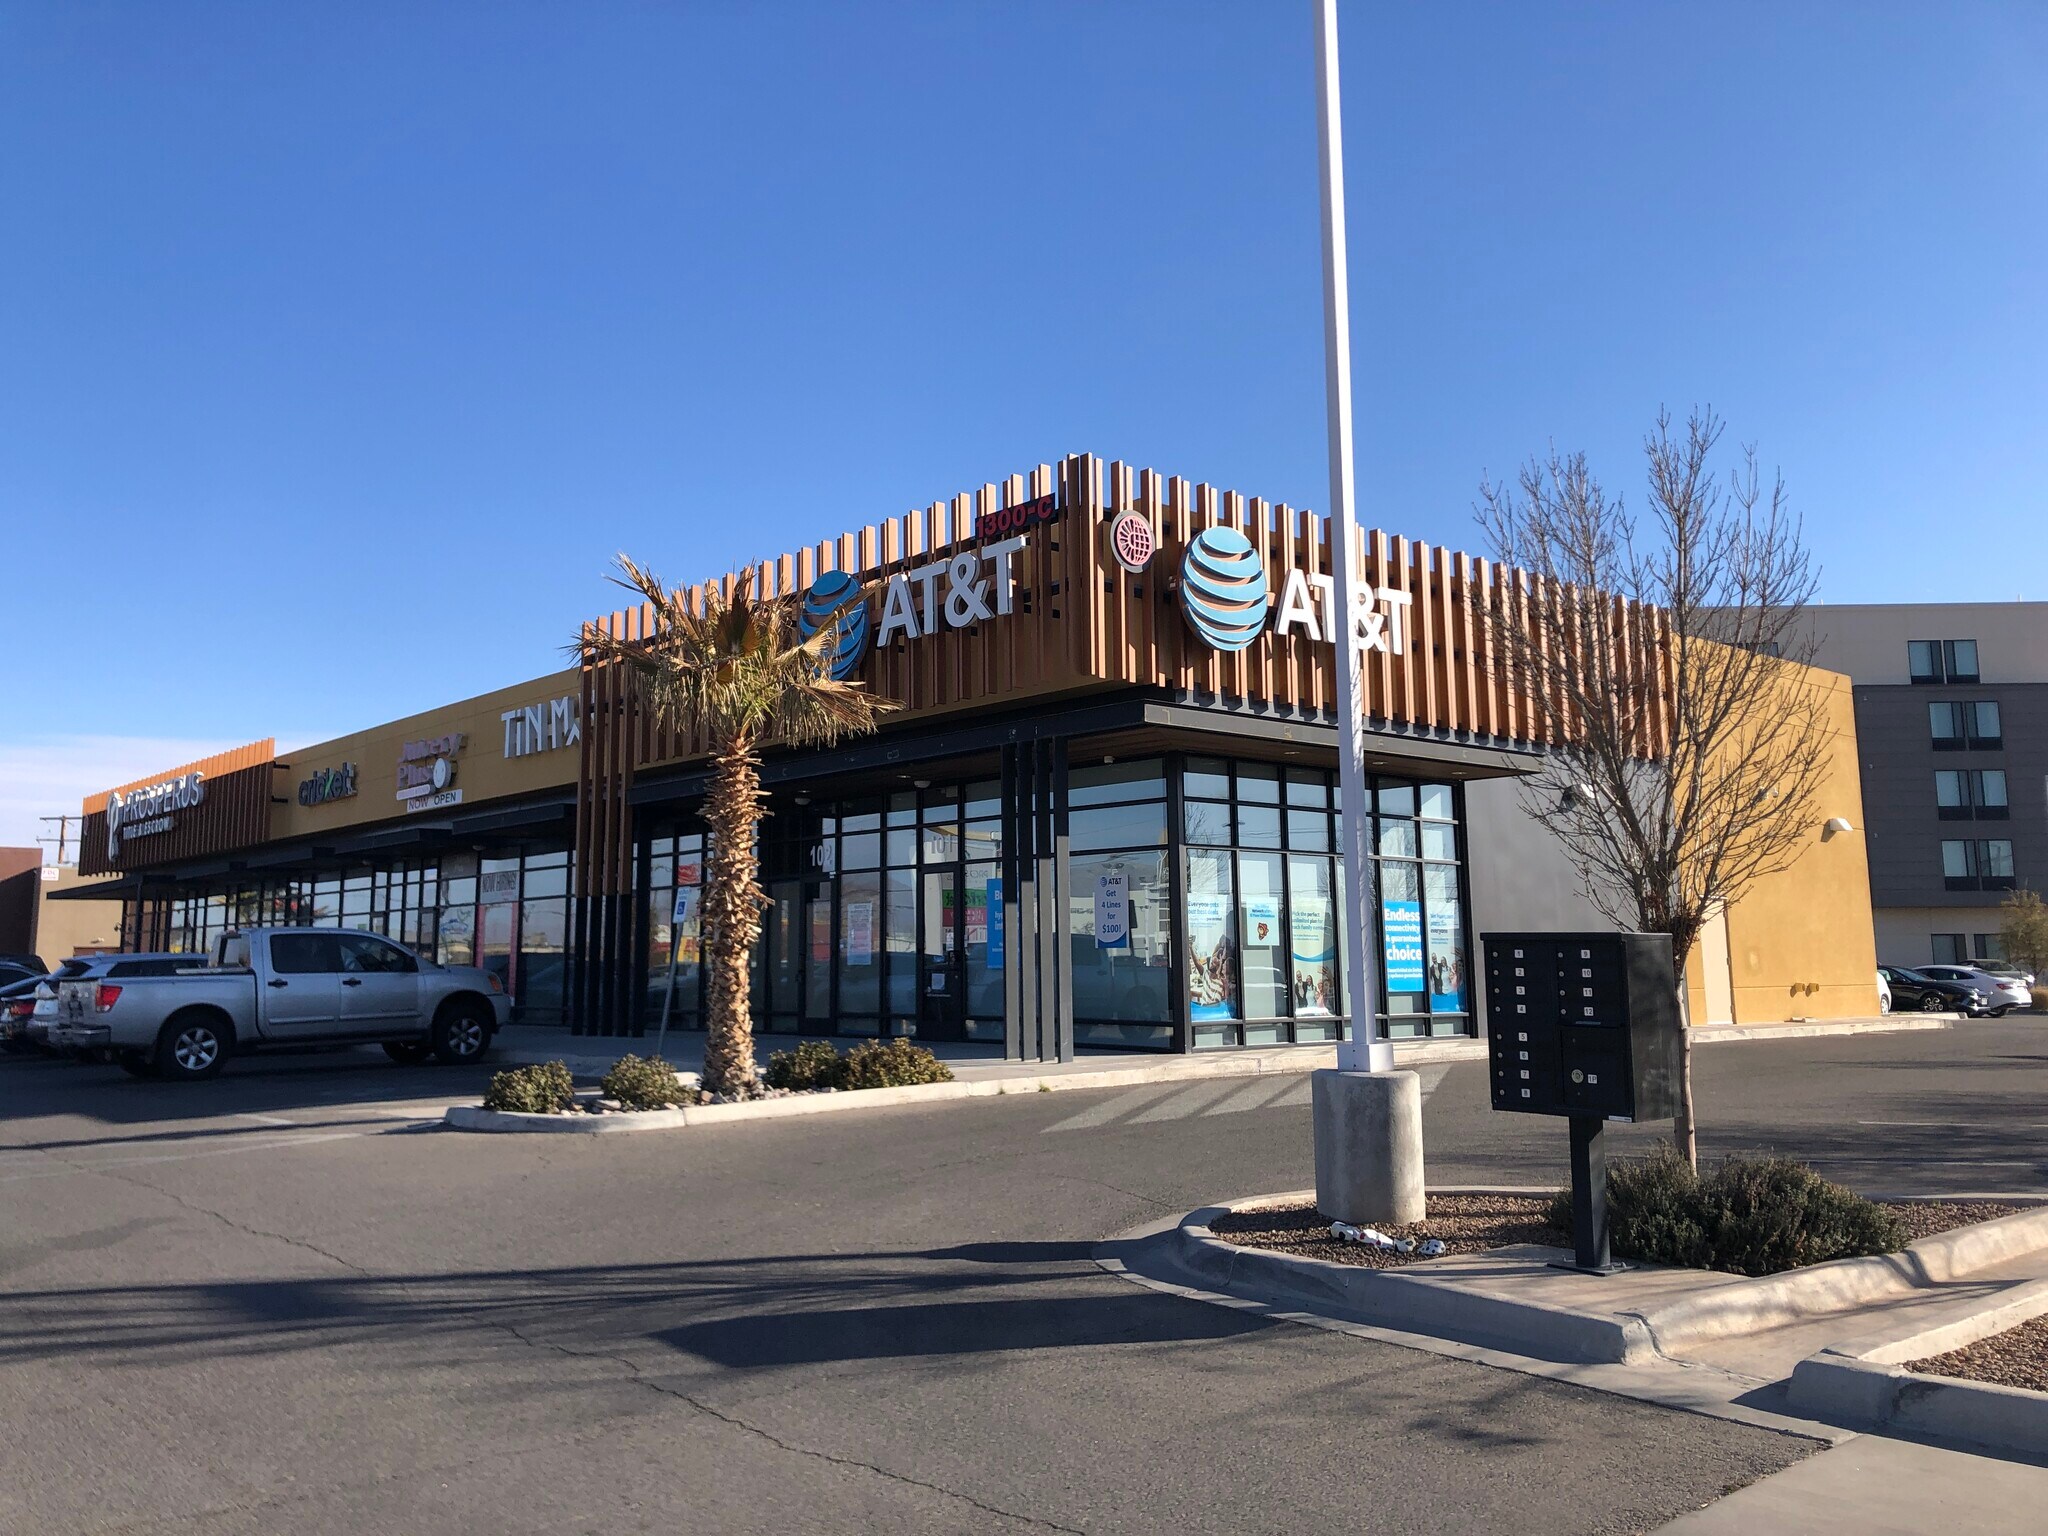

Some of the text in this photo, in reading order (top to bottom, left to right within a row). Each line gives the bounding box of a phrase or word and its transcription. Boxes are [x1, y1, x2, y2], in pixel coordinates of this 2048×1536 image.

[976, 496, 1053, 538] 1300-C
[877, 535, 1026, 647] AT&T
[1274, 569, 1412, 655] AT&T
[299, 761, 356, 806] cricket
[122, 771, 204, 823] PROSPERUS
[408, 797, 429, 811] NOW
[434, 791, 457, 805] OPEN
[931, 833, 954, 855] 101
[1384, 907, 1420, 922] Endless
[1102, 924, 1121, 933] $100!
[1385, 924, 1420, 933] connectivity
[1391, 934, 1421, 944] guaranteed
[1386, 945, 1422, 960] choice
